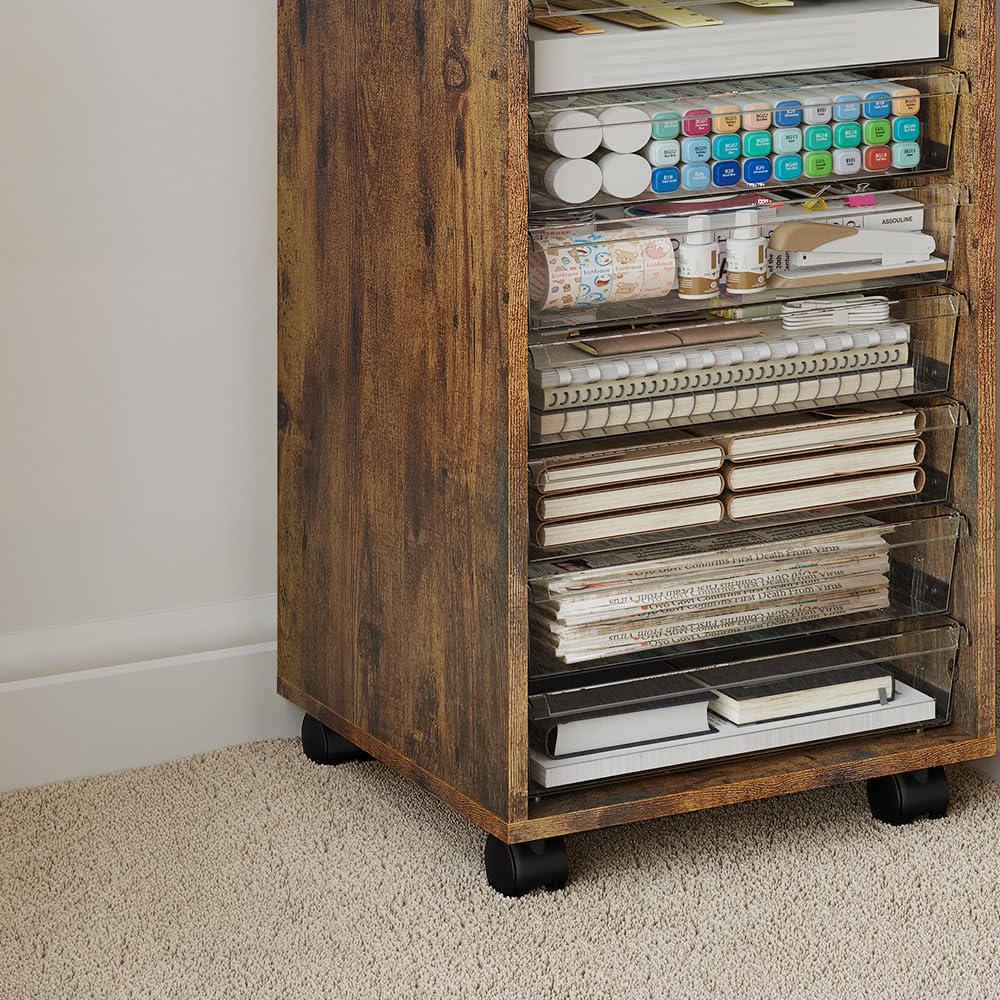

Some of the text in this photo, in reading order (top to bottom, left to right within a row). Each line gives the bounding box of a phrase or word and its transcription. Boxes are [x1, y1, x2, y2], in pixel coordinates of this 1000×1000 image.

[881, 215, 914, 225] ASSOULINE
[768, 265, 774, 273] of
[755, 549, 785, 561] Death
[786, 546, 813, 557] From
[814, 544, 841, 554] Virus
[758, 590, 787, 600] Death
[789, 585, 815, 596] From
[816, 582, 843, 592] Virus
